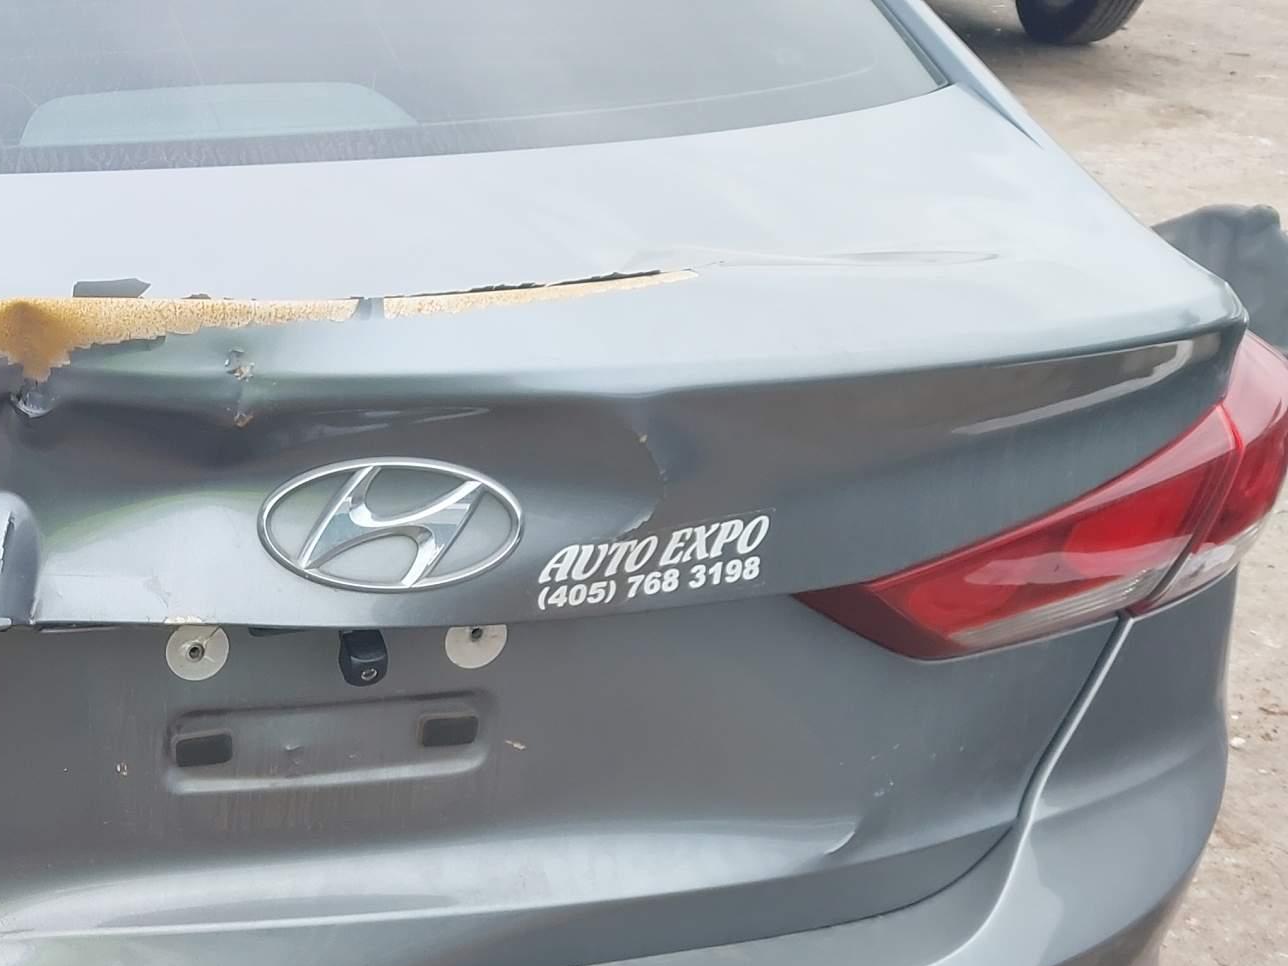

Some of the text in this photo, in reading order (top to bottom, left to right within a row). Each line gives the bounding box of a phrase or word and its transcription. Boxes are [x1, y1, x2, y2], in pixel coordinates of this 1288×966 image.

[538, 515, 770, 584] AUTO EXPO
[538, 557, 761, 611] (405) 768 3198
